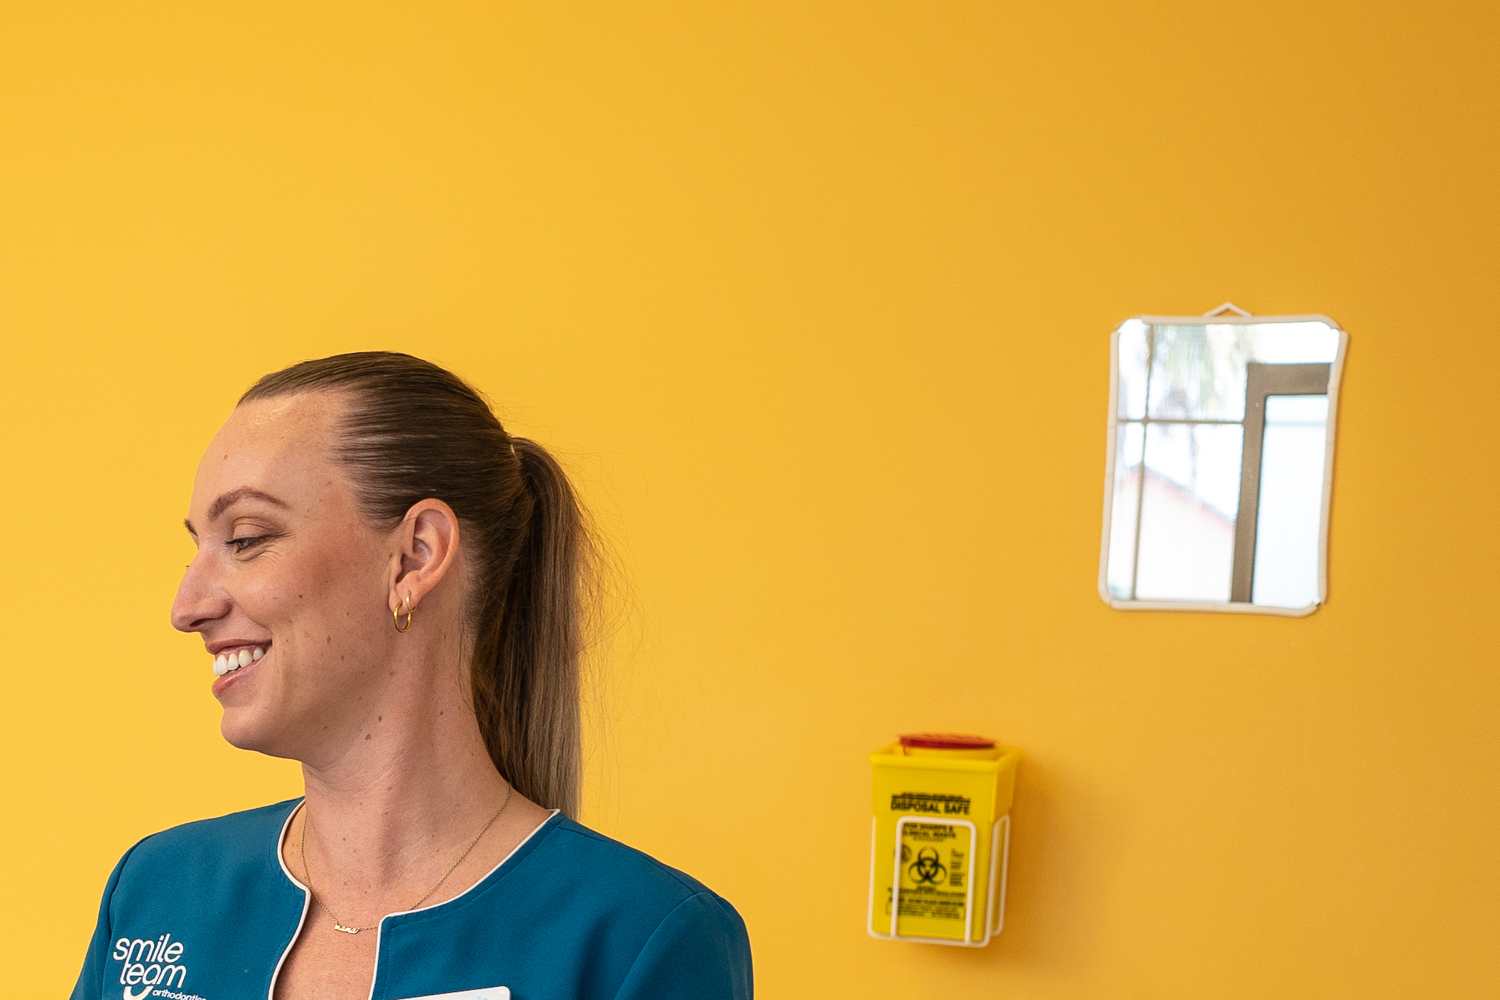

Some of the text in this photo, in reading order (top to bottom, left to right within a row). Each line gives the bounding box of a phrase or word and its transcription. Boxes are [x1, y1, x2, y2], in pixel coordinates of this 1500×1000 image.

[891, 799, 970, 815] DISPOSAL SAFE
[113, 933, 184, 964] smile
[120, 962, 187, 989] team
